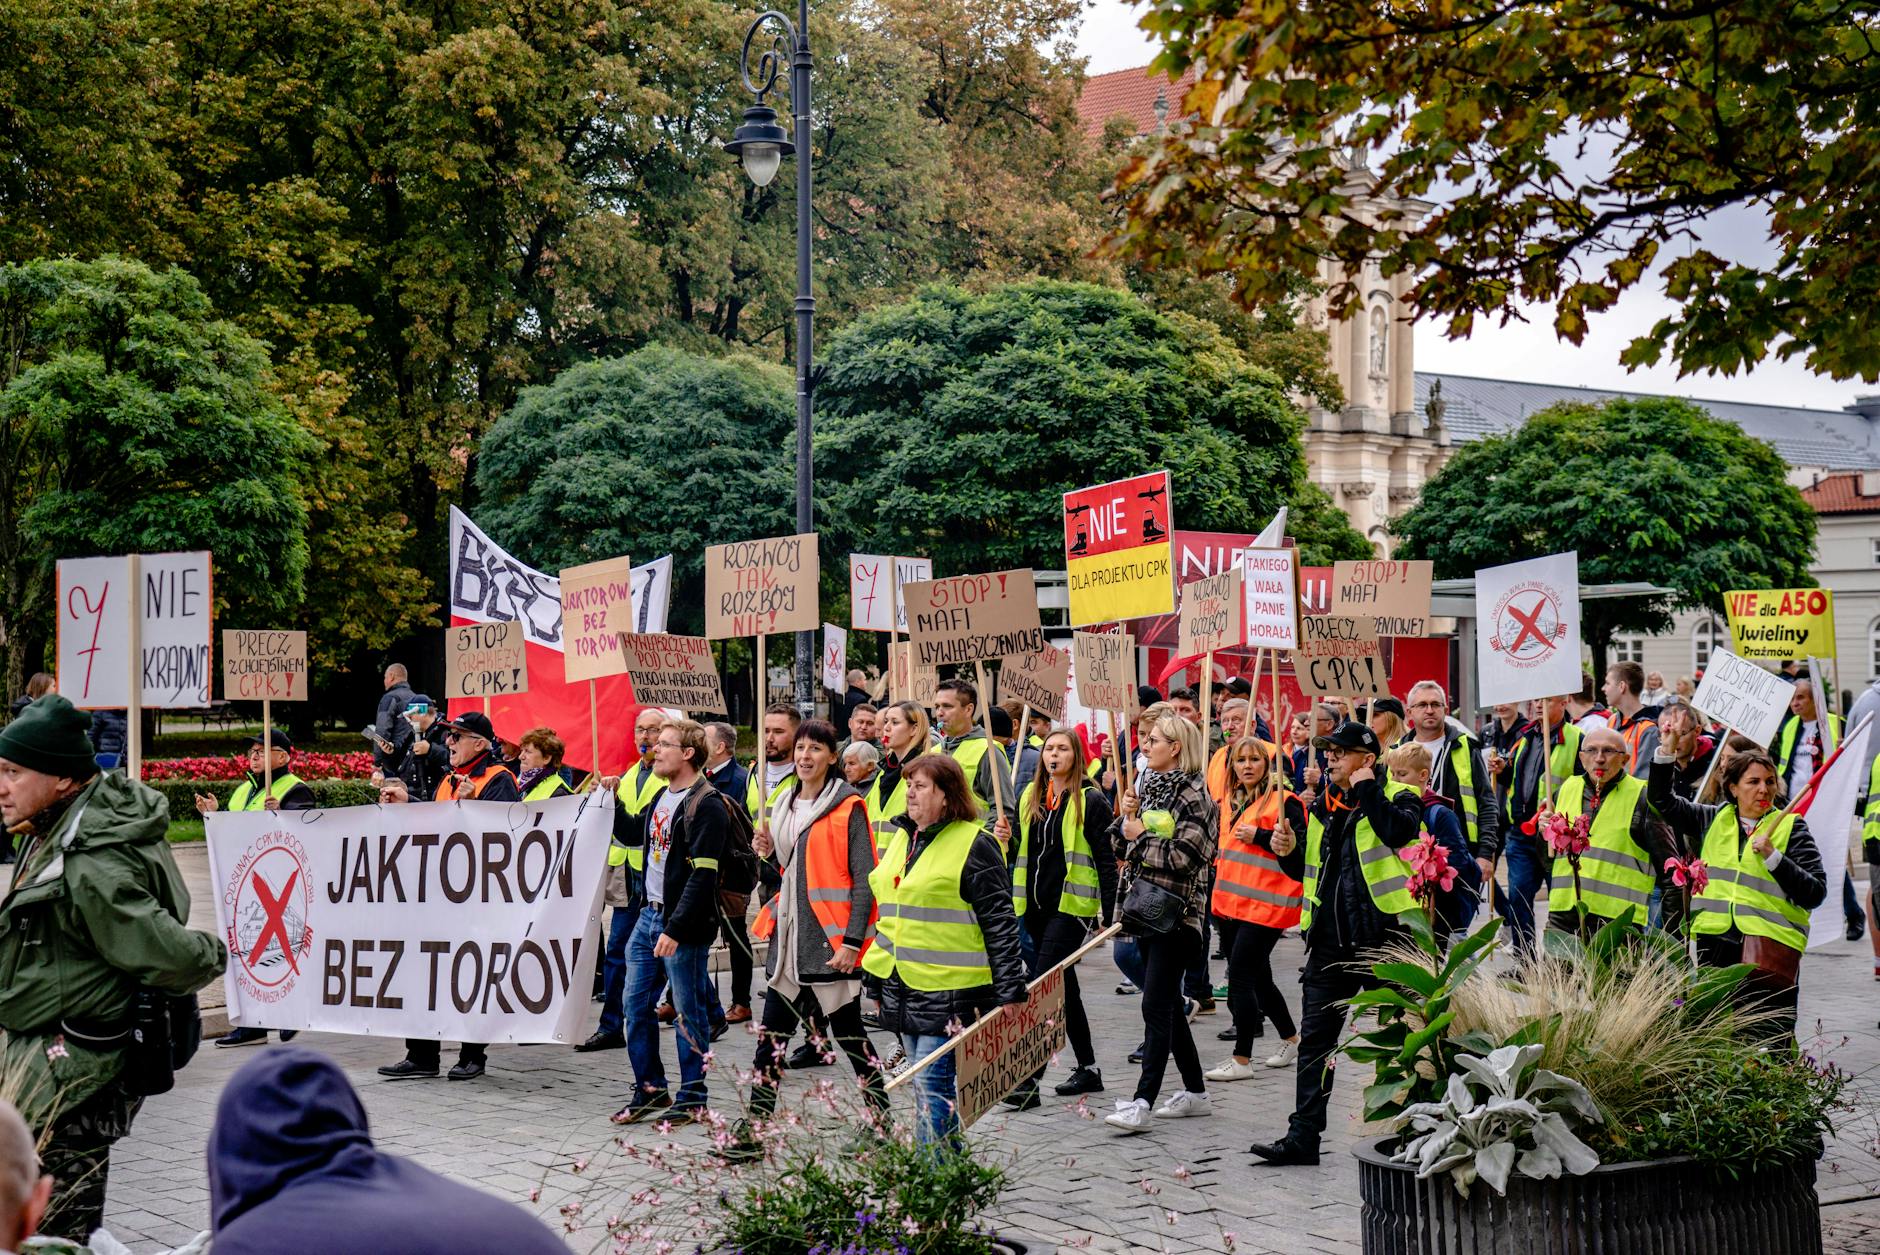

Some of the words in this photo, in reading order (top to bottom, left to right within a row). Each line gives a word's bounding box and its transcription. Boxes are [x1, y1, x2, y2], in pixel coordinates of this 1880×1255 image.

[1089, 497, 1127, 544] NIE
[723, 538, 800, 572] ROZWÓJ
[1247, 557, 1289, 572] TAKIEGO
[734, 566, 777, 591] TAK
[1071, 573, 1090, 591] DLA
[1091, 563, 1144, 588] PROJEKTU
[1146, 558, 1168, 578] CPK
[1254, 580, 1284, 594] WAŁA
[147, 568, 200, 619] NIE
[721, 584, 795, 616] ROZBÓJ
[1341, 584, 1377, 602] MAFI
[1760, 603, 1777, 617] dla
[1778, 590, 1828, 616] A50
[1196, 598, 1220, 615] TAK
[1255, 601, 1286, 616] PANIE
[583, 611, 606, 633] BEZ
[733, 609, 777, 637] NIE!
[917, 607, 970, 632] MAFI
[1250, 624, 1292, 640] HORAŁA
[1302, 616, 1360, 641] PRECZ
[235, 630, 292, 656] PRECZ
[457, 622, 508, 651] STOP
[1737, 624, 1809, 645] Uwieliny
[1077, 636, 1095, 659] NIE
[228, 659, 238, 675] Z
[634, 650, 661, 671] POD
[664, 652, 695, 671] CPK
[1020, 655, 1038, 672] DO
[1089, 660, 1111, 685] SIĘ
[322, 938, 405, 1010] BEZ
